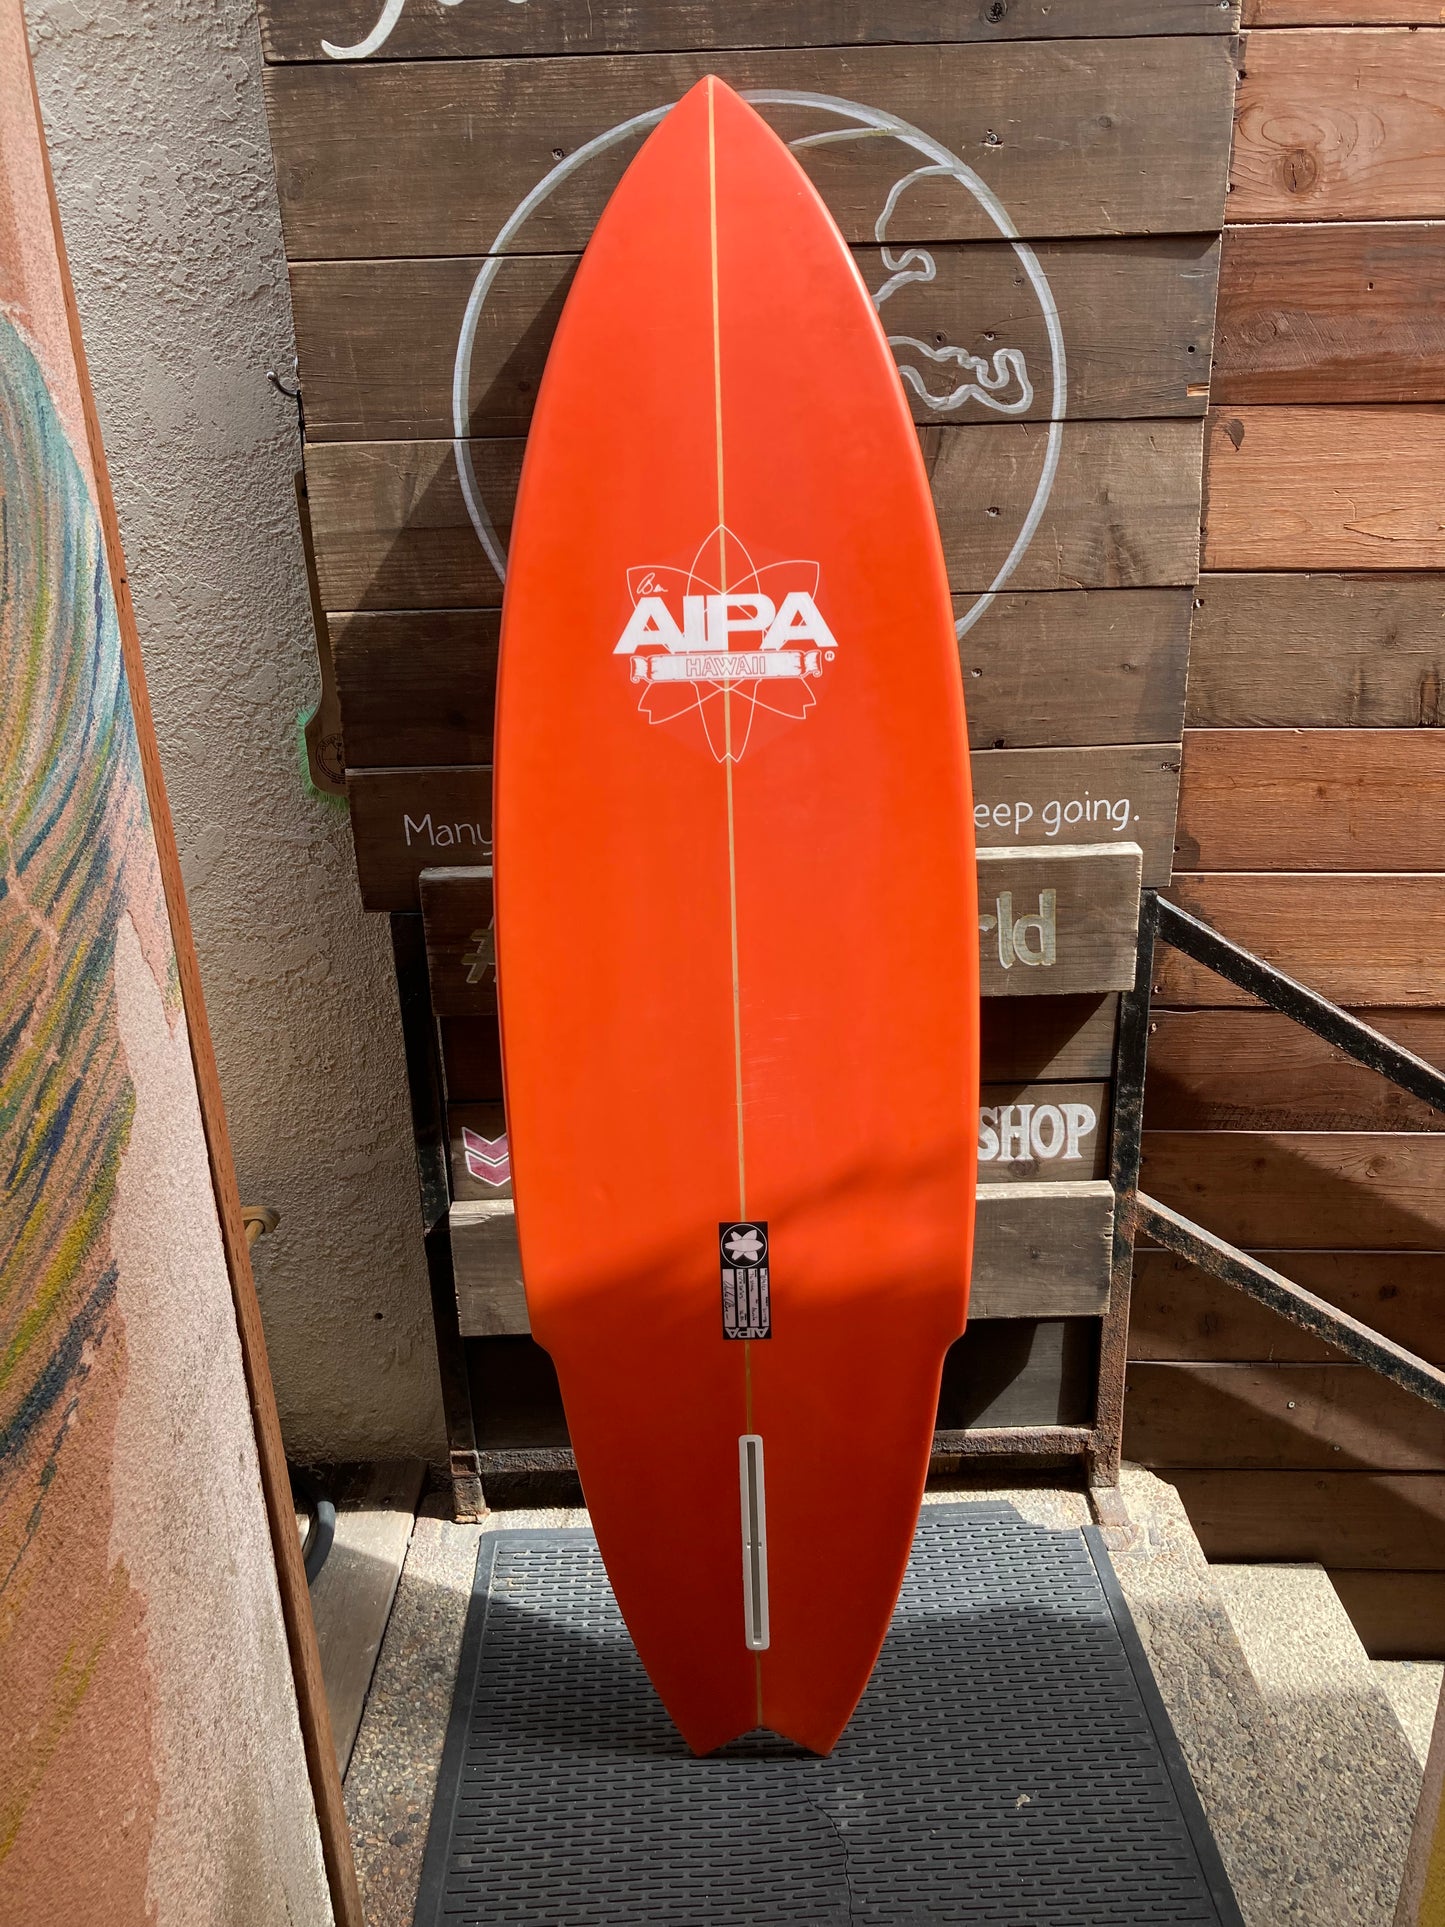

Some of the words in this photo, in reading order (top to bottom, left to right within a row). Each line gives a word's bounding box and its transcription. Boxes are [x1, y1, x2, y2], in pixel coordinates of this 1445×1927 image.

[612, 591, 839, 655] AIPA
[685, 655, 767, 678] HAWAII
[973, 803, 1034, 836] eep
[1041, 790, 1140, 837] going.
[977, 1103, 1097, 1162] SHOP
